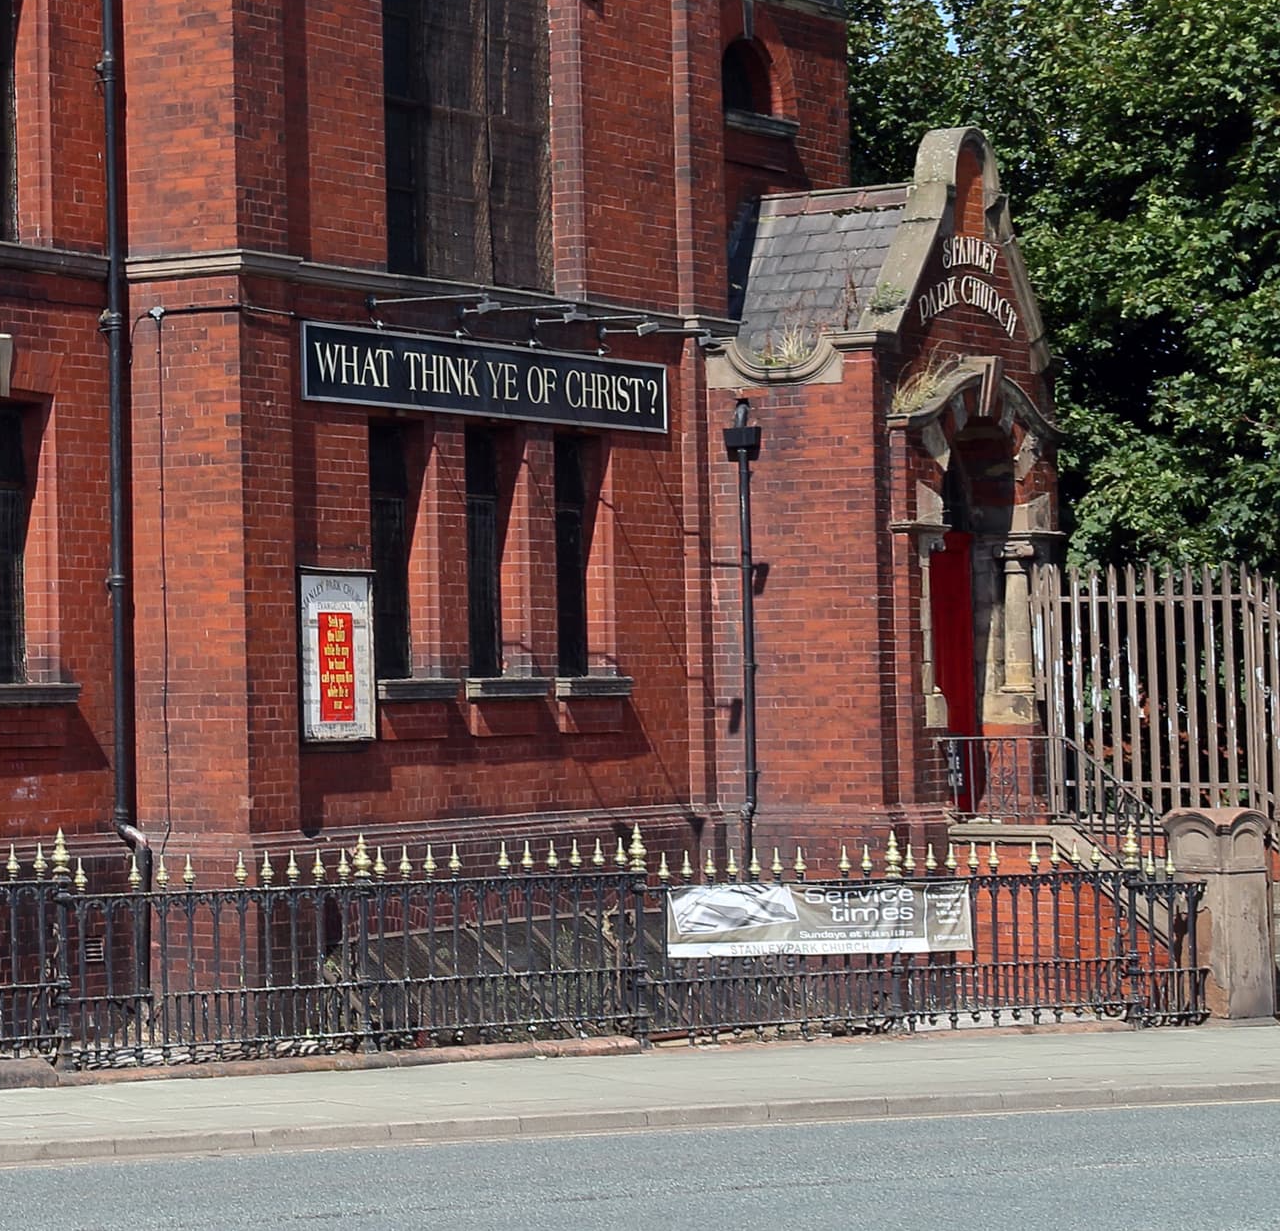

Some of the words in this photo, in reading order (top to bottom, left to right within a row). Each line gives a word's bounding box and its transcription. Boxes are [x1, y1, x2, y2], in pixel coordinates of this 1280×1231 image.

[942, 235, 998, 275] STANLEY
[918, 276, 959, 327] PARK
[961, 275, 1018, 339] CHURCH
[315, 341, 393, 388] WHAT
[403, 351, 480, 397] THINK
[486, 361, 519, 401] YE
[527, 366, 557, 404] OF
[804, 887, 915, 904] Service
[830, 903, 915, 922] times
[730, 944, 784, 955] STANLEY
[785, 942, 820, 954] PARK
[821, 942, 870, 953] CHURCH
